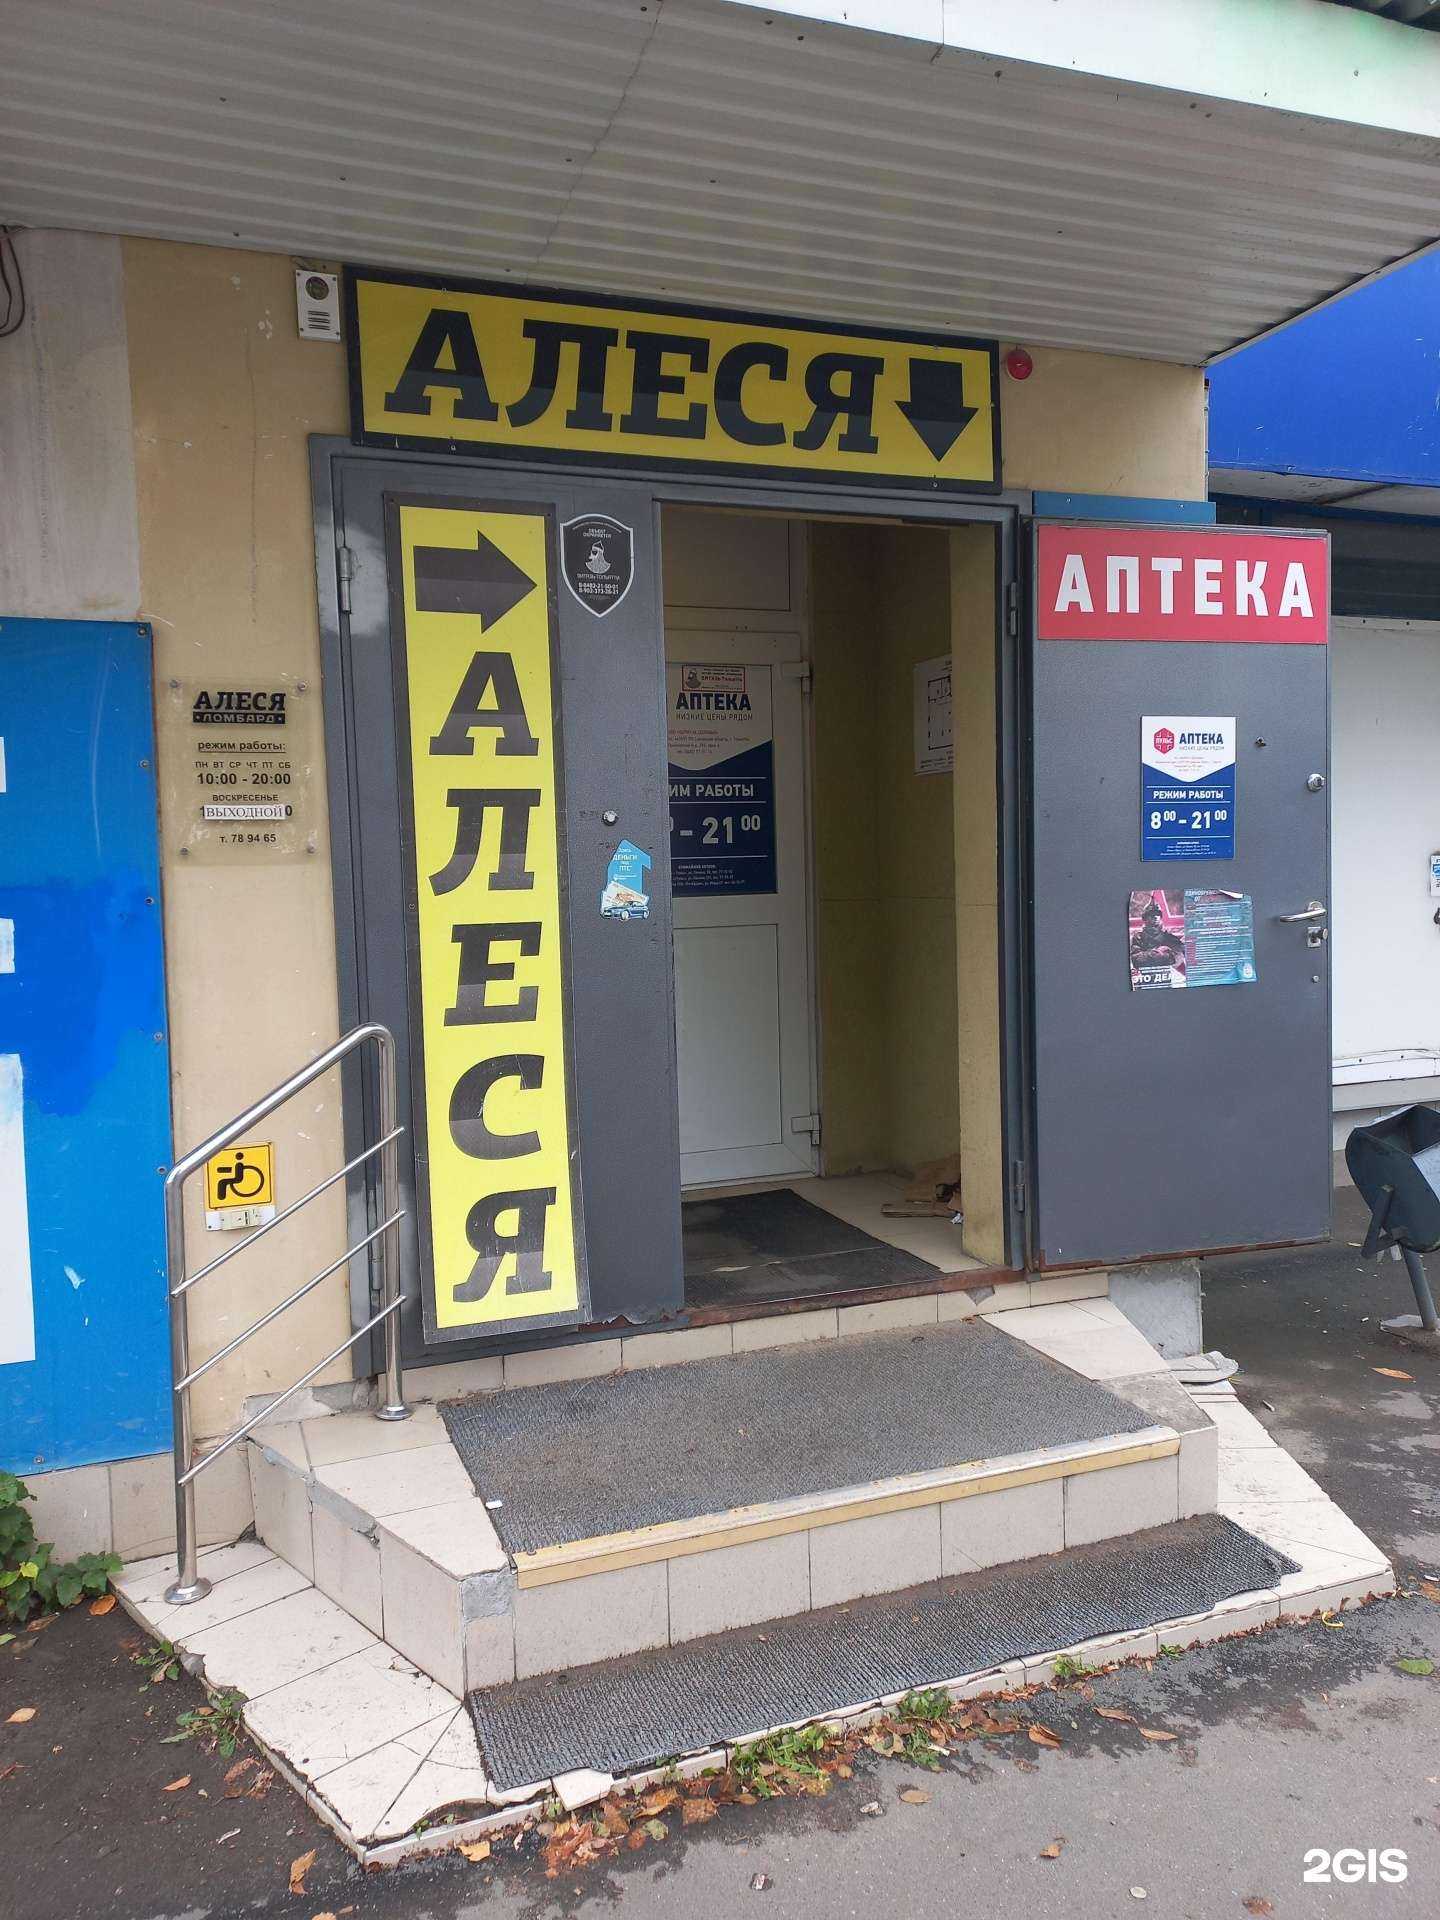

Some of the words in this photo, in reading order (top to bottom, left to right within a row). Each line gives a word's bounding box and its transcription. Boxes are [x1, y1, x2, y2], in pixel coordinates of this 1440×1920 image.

[384, 308, 885, 456] АЛЕСЯ
[1054, 553, 1314, 618] АПТЕКА
[193, 691, 287, 711] АЛЕСЯ
[676, 692, 752, 711] АПТЕКА
[202, 713, 275, 723] ЛОМБАРД
[1178, 733, 1224, 745] АПТЕКА
[198, 742, 236, 751] режим
[239, 741, 286, 751] работы:
[197, 773, 237, 785] 10:00
[252, 773, 291, 785] 20:00
[695, 784, 754, 797] РАБОТЫ
[1153, 790, 1187, 800] РЕЖИМ
[1188, 790, 1224, 800] РАБОТЫ
[212, 794, 279, 802] ВОСКРЕСЕНЬЕ
[205, 804, 283, 818] ВЫХОДНОЙ
[1150, 811, 1162, 830] 8
[1163, 810, 1177, 821] 00
[1191, 811, 1211, 829] 21
[1214, 810, 1228, 821] 00
[702, 817, 733, 844] 21
[741, 815, 761, 831] 00
[231, 834, 244, 843] 78
[247, 834, 260, 843] 94
[264, 834, 276, 843] 65
[428, 651, 556, 1303] АЛЕСЯ
